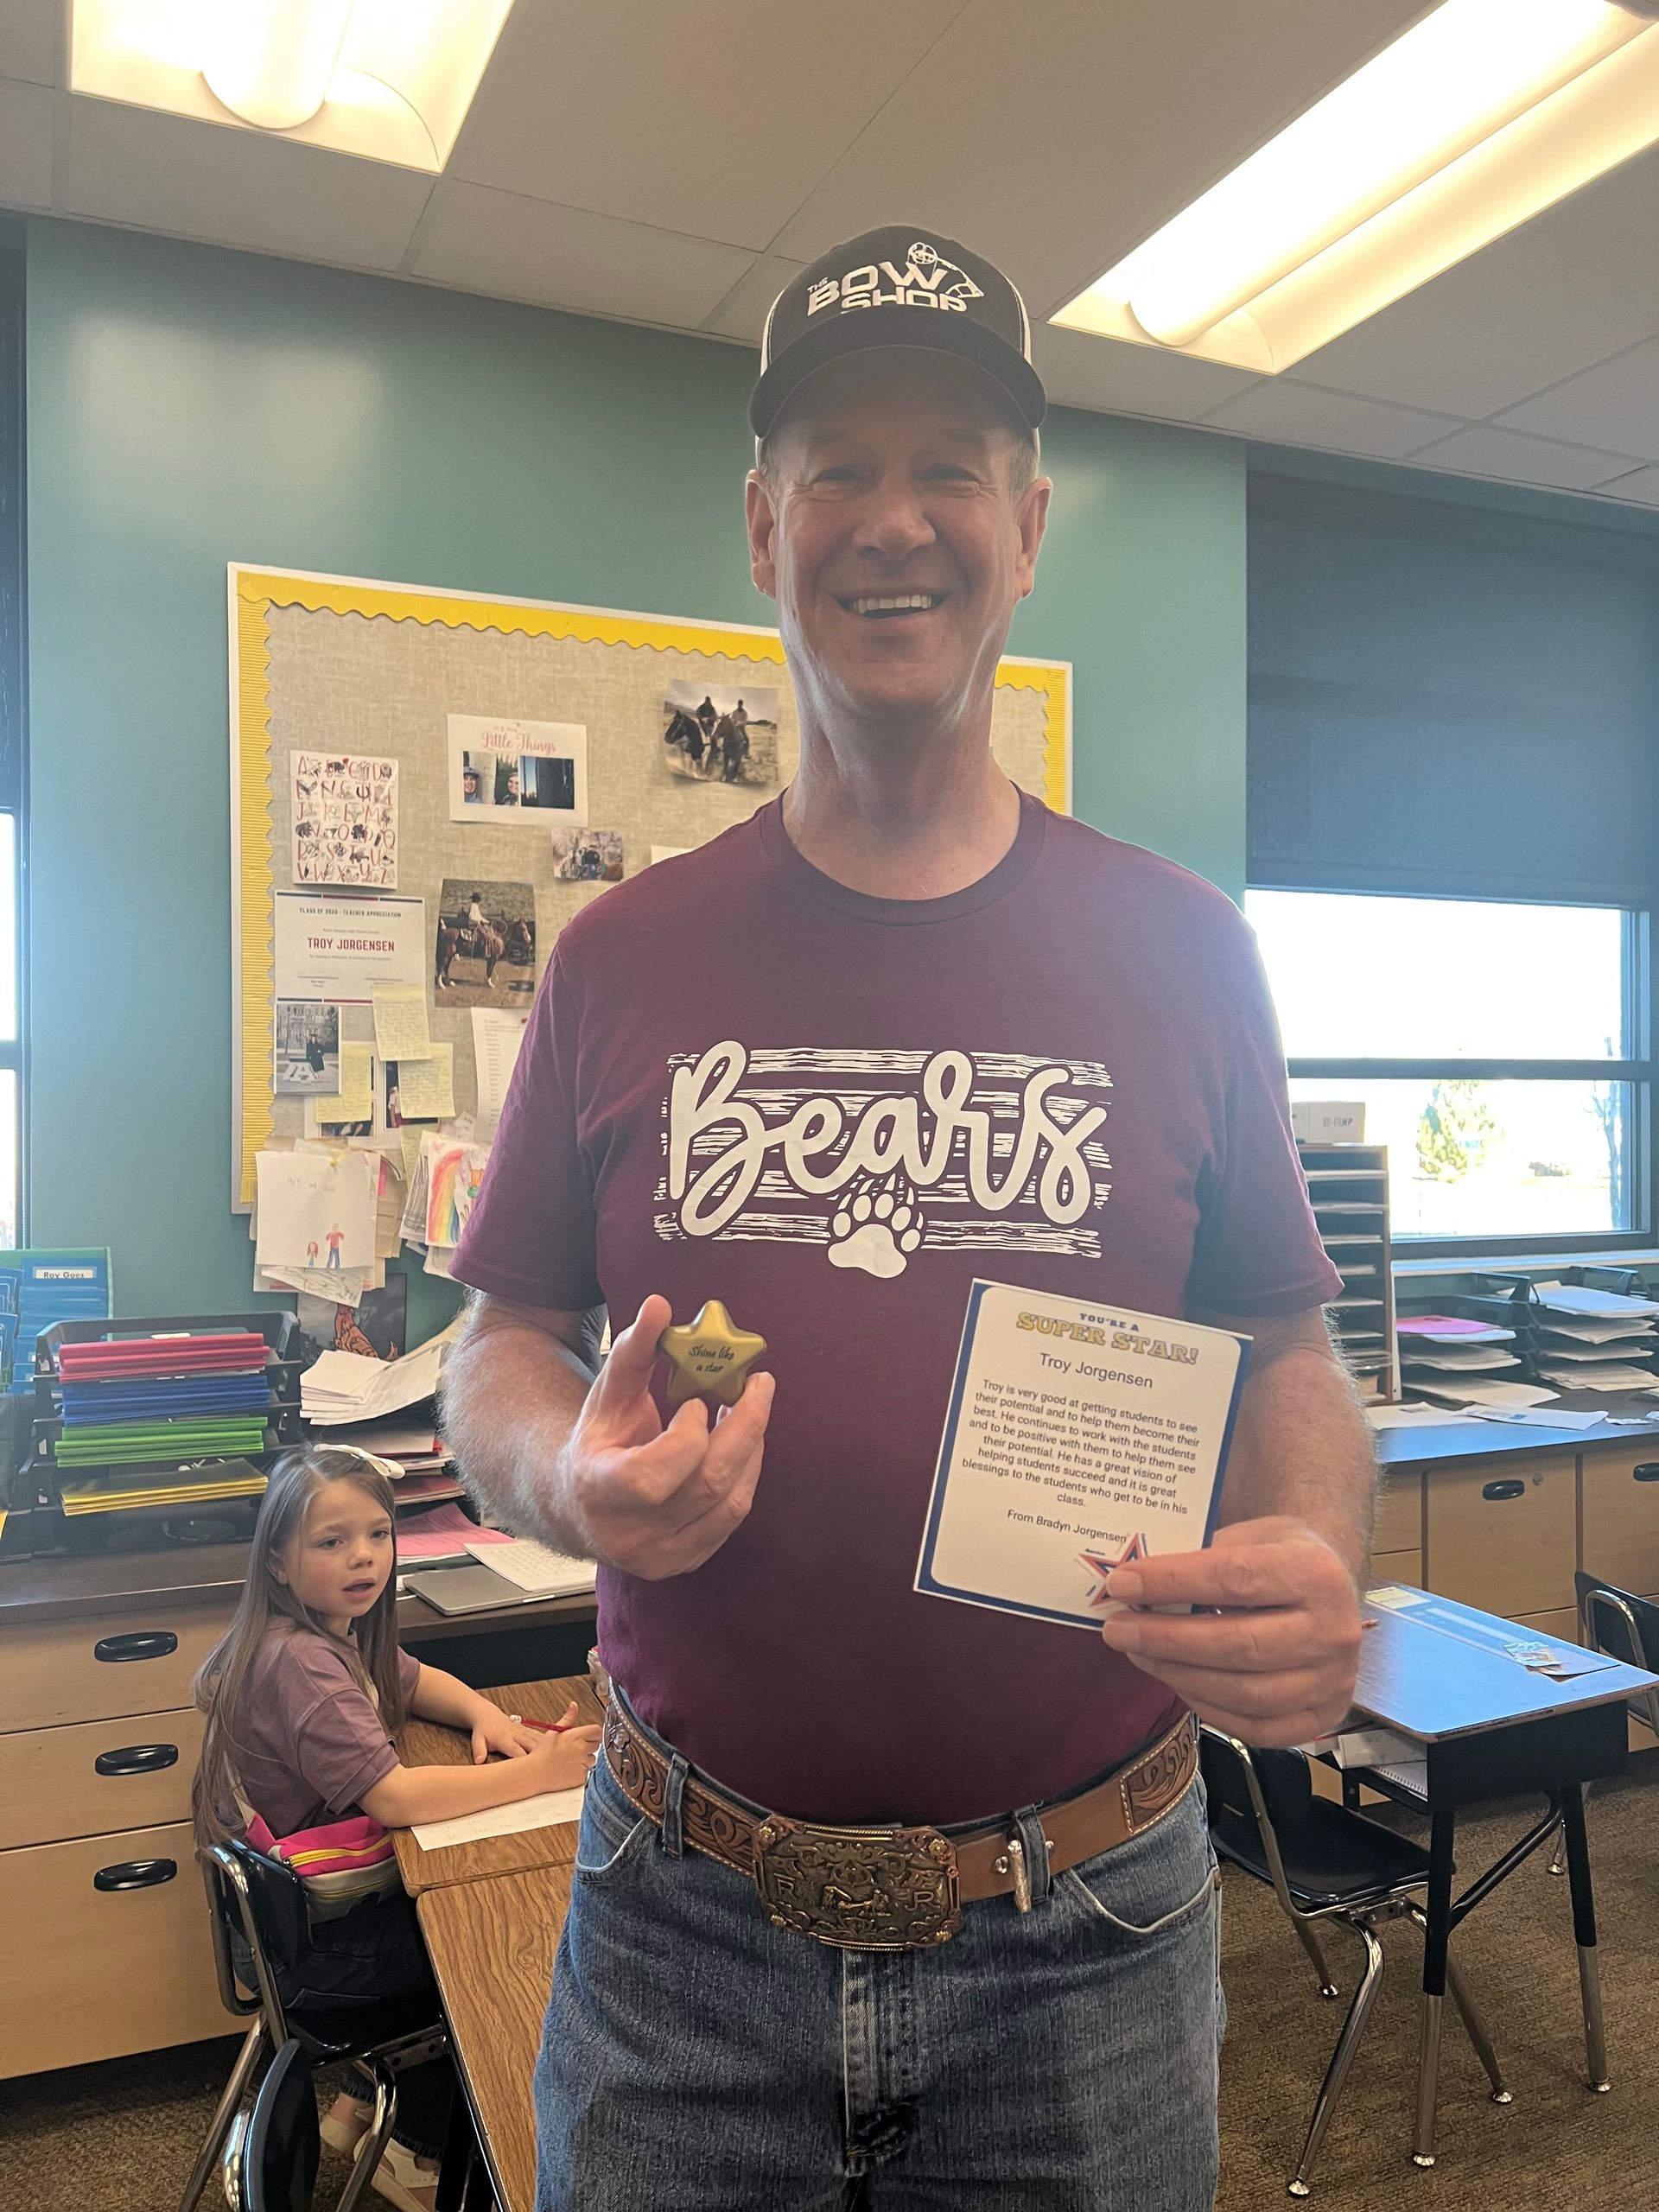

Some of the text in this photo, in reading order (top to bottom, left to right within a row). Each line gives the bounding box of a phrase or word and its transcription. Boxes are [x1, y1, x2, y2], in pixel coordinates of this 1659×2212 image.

[807, 261, 948, 316] THE BOW
[841, 287, 967, 315] SHOP
[481, 732, 556, 755] Little Things
[308, 938, 394, 951] TROY JORGENSEN
[670, 1040, 1107, 1236] Bears
[1015, 1312, 1198, 1364] SUPER STAR!
[1079, 1313, 1126, 1328] YOU'RE
[689, 1345, 734, 1360] Shine like
[704, 1363, 724, 1373] star
[1039, 1351, 1153, 1388] Troy Jorgensen
[975, 1391, 1200, 1446] their potential and to help them become their
[982, 1378, 1198, 1433] Troy is very good at getting students to see
[969, 1419, 1196, 1473] and to be positive with them to help them see
[973, 1403, 1196, 1460] best. He continues to work with the students
[977, 1446, 1176, 1498] helping students succeed and it is great
[983, 1434, 1177, 1484] their potential. He has a great vision of
[962, 1457, 1187, 1514] blessings to the students who get to be in his
[1057, 1492, 1085, 1507] class.
[1007, 1509, 1127, 1543] From Bradyn Jorgensen
